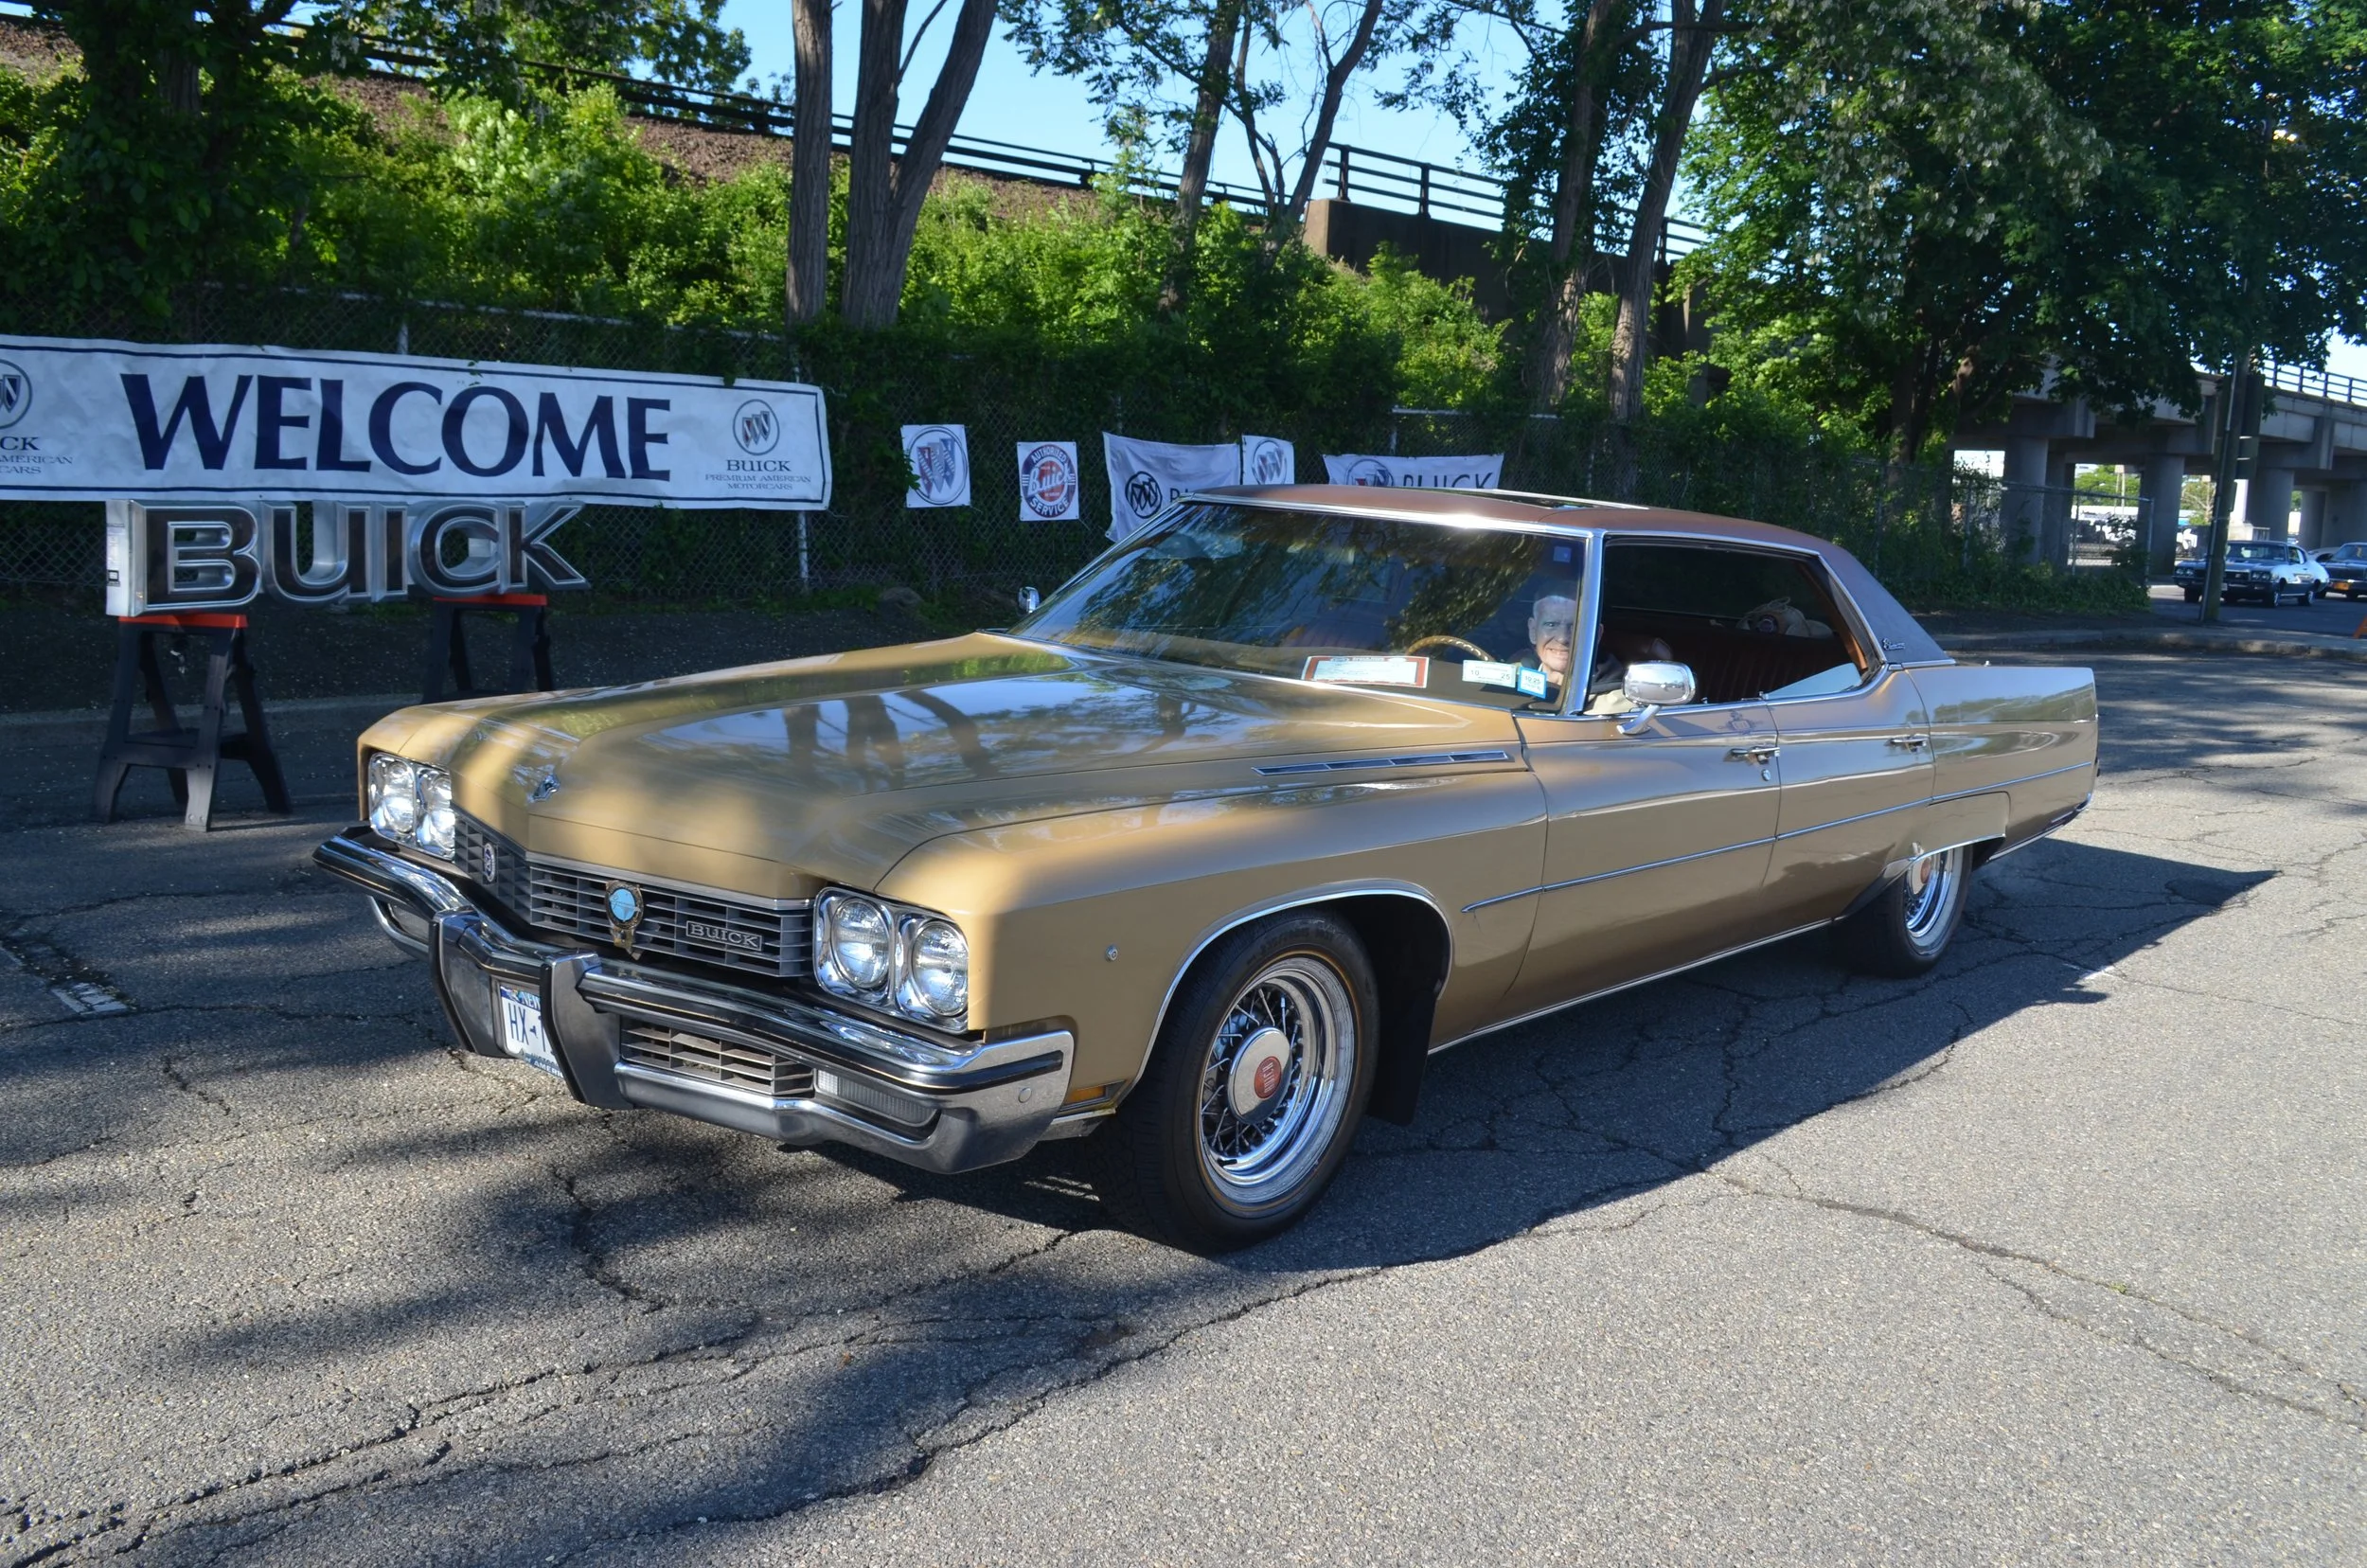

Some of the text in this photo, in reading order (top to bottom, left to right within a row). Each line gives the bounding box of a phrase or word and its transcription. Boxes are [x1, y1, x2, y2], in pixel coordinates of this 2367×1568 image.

[120, 373, 671, 481] WELCOME
[726, 459, 792, 472] BUICK
[1031, 446, 1067, 463] AUTHORIZED
[704, 473, 811, 483] PREMIUM AMERICAN
[1027, 461, 1073, 496] Buick
[1029, 496, 1070, 516] SERVICE
[128, 500, 590, 616] BUICK
[690, 923, 758, 948] BUICK
